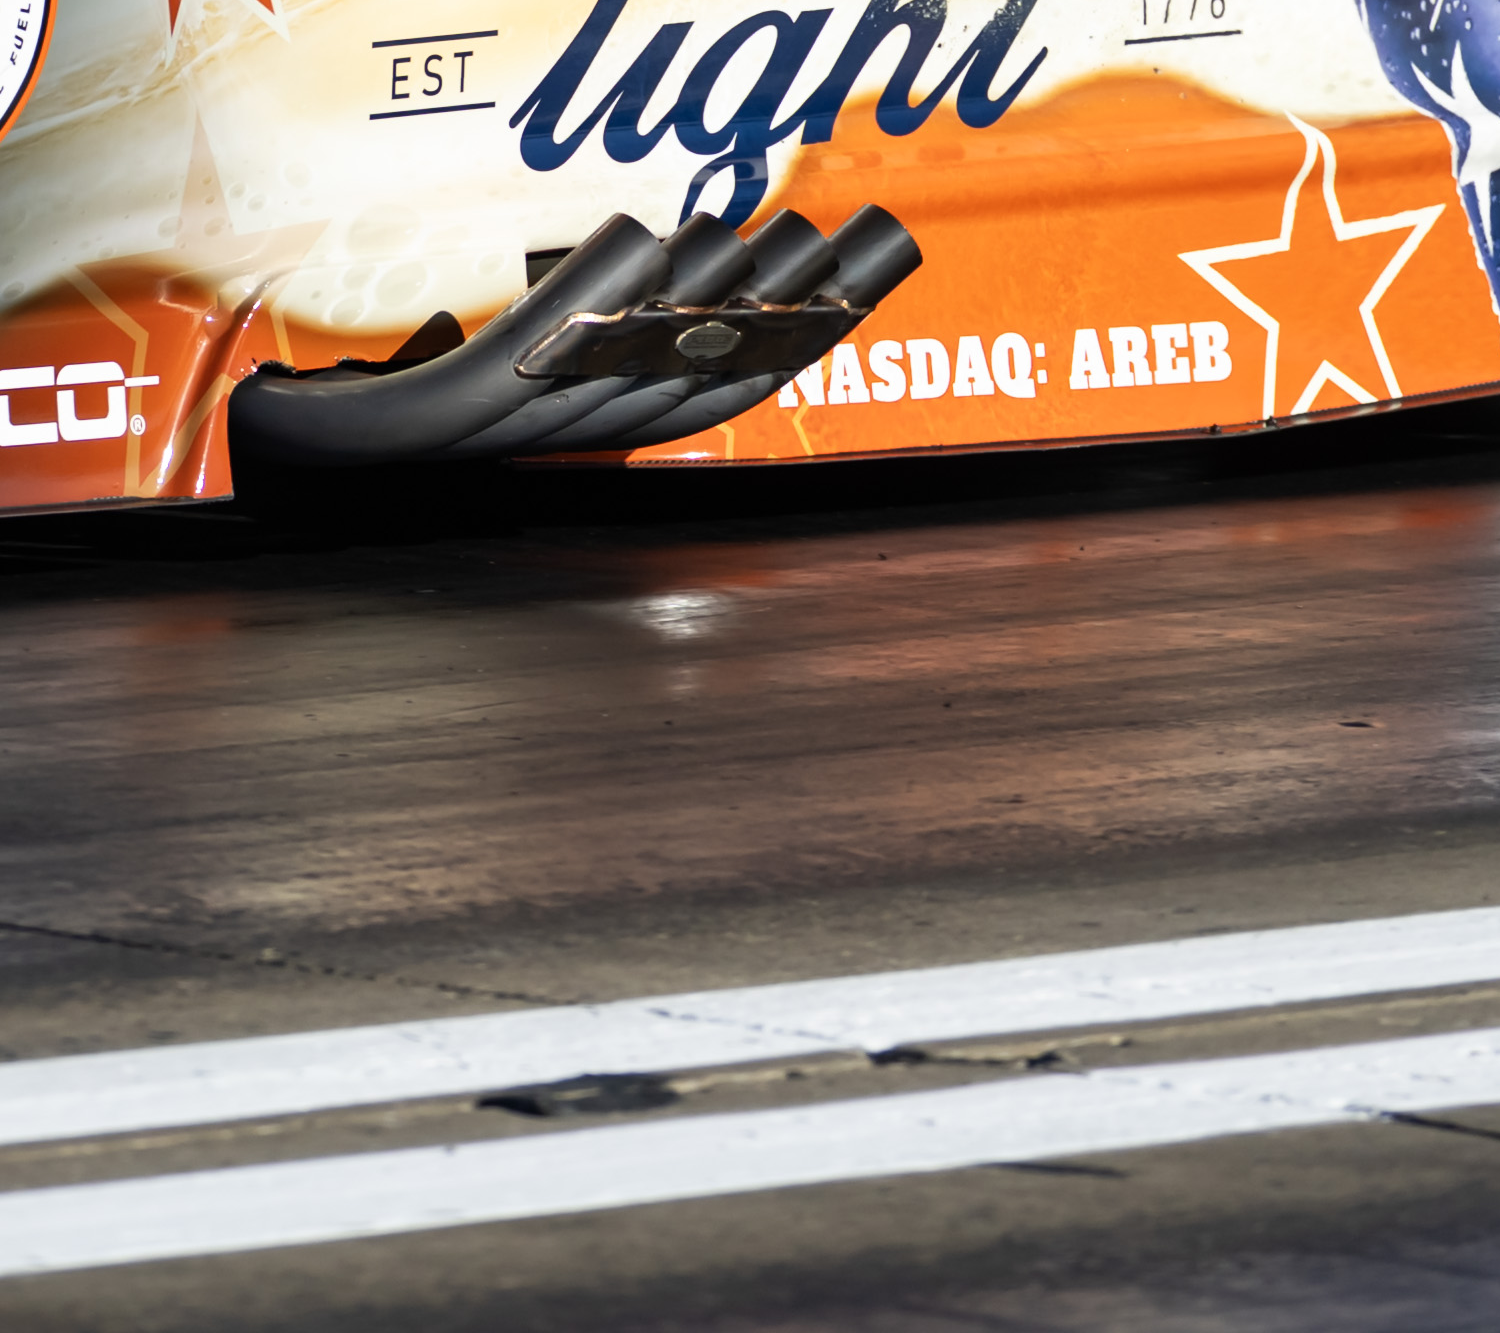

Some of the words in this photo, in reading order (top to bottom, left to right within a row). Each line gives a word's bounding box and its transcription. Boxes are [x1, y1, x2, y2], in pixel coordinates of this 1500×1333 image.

[8, 2, 32, 66] FUEL
[390, 49, 475, 101] EST
[777, 331, 1048, 411] NASDAQ:
[1068, 319, 1234, 393] AREB
